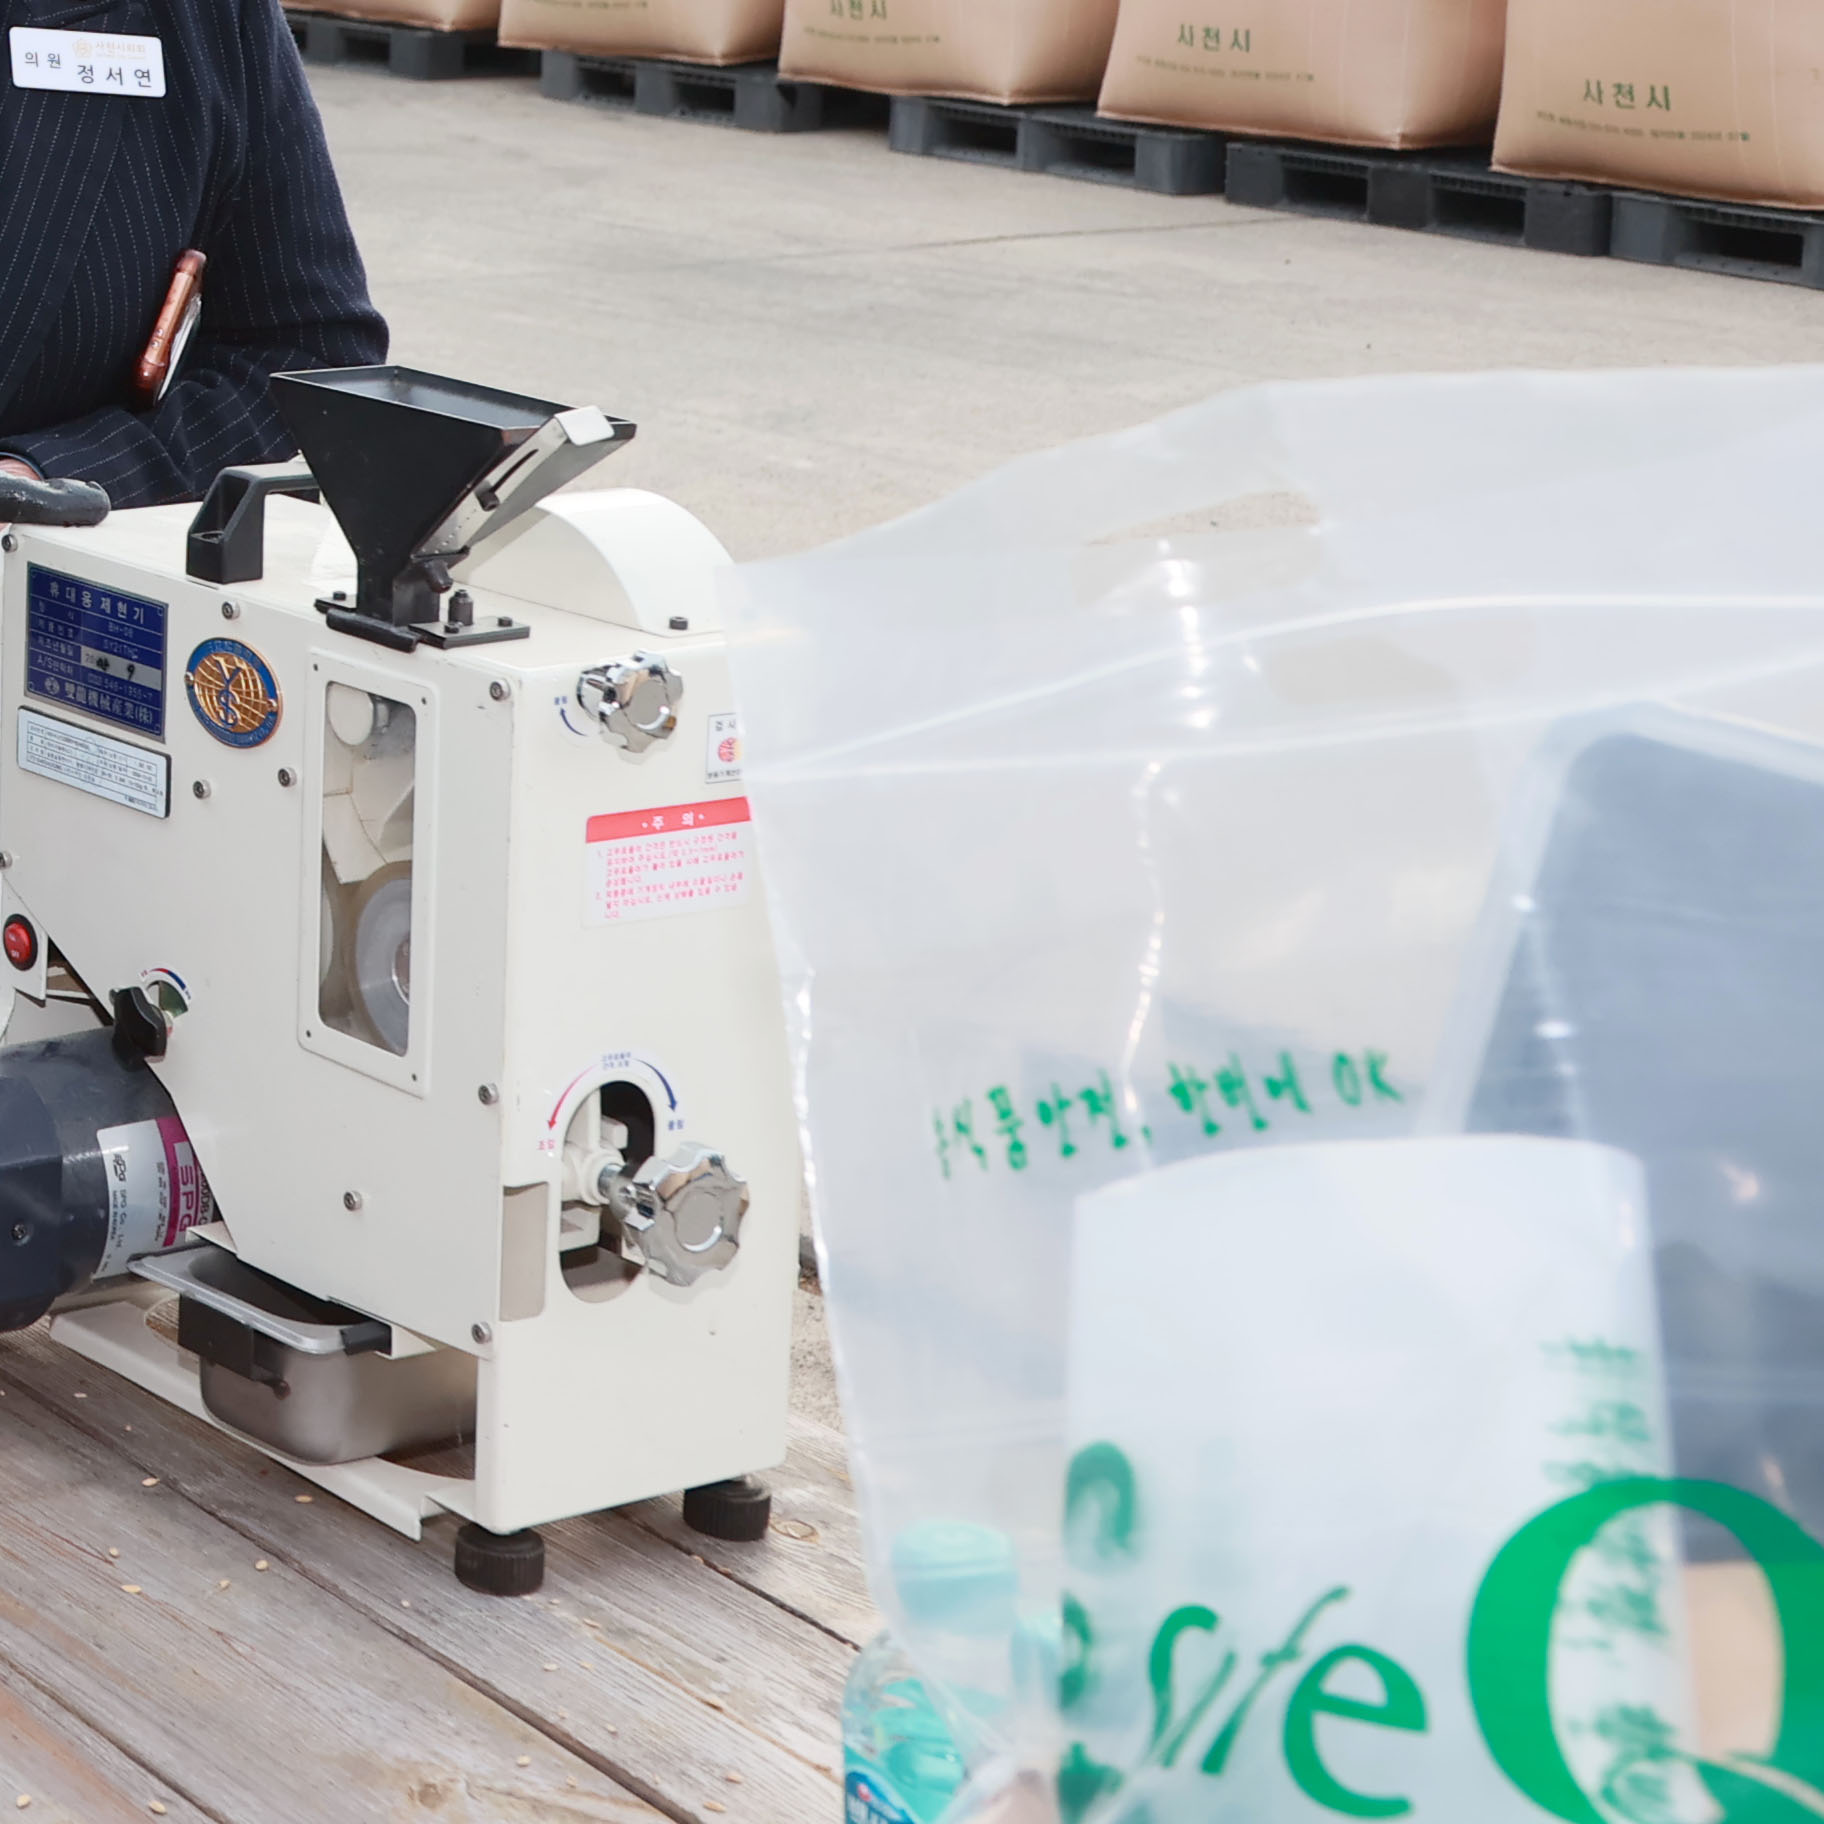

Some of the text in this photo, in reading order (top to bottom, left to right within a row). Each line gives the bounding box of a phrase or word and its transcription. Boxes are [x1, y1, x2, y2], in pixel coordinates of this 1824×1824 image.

[77, 64, 152, 88] 정서연
[1584, 79, 1671, 111] 사천시
[1332, 1048, 1404, 1107] OK
[179, 1165, 195, 1232] SPG
